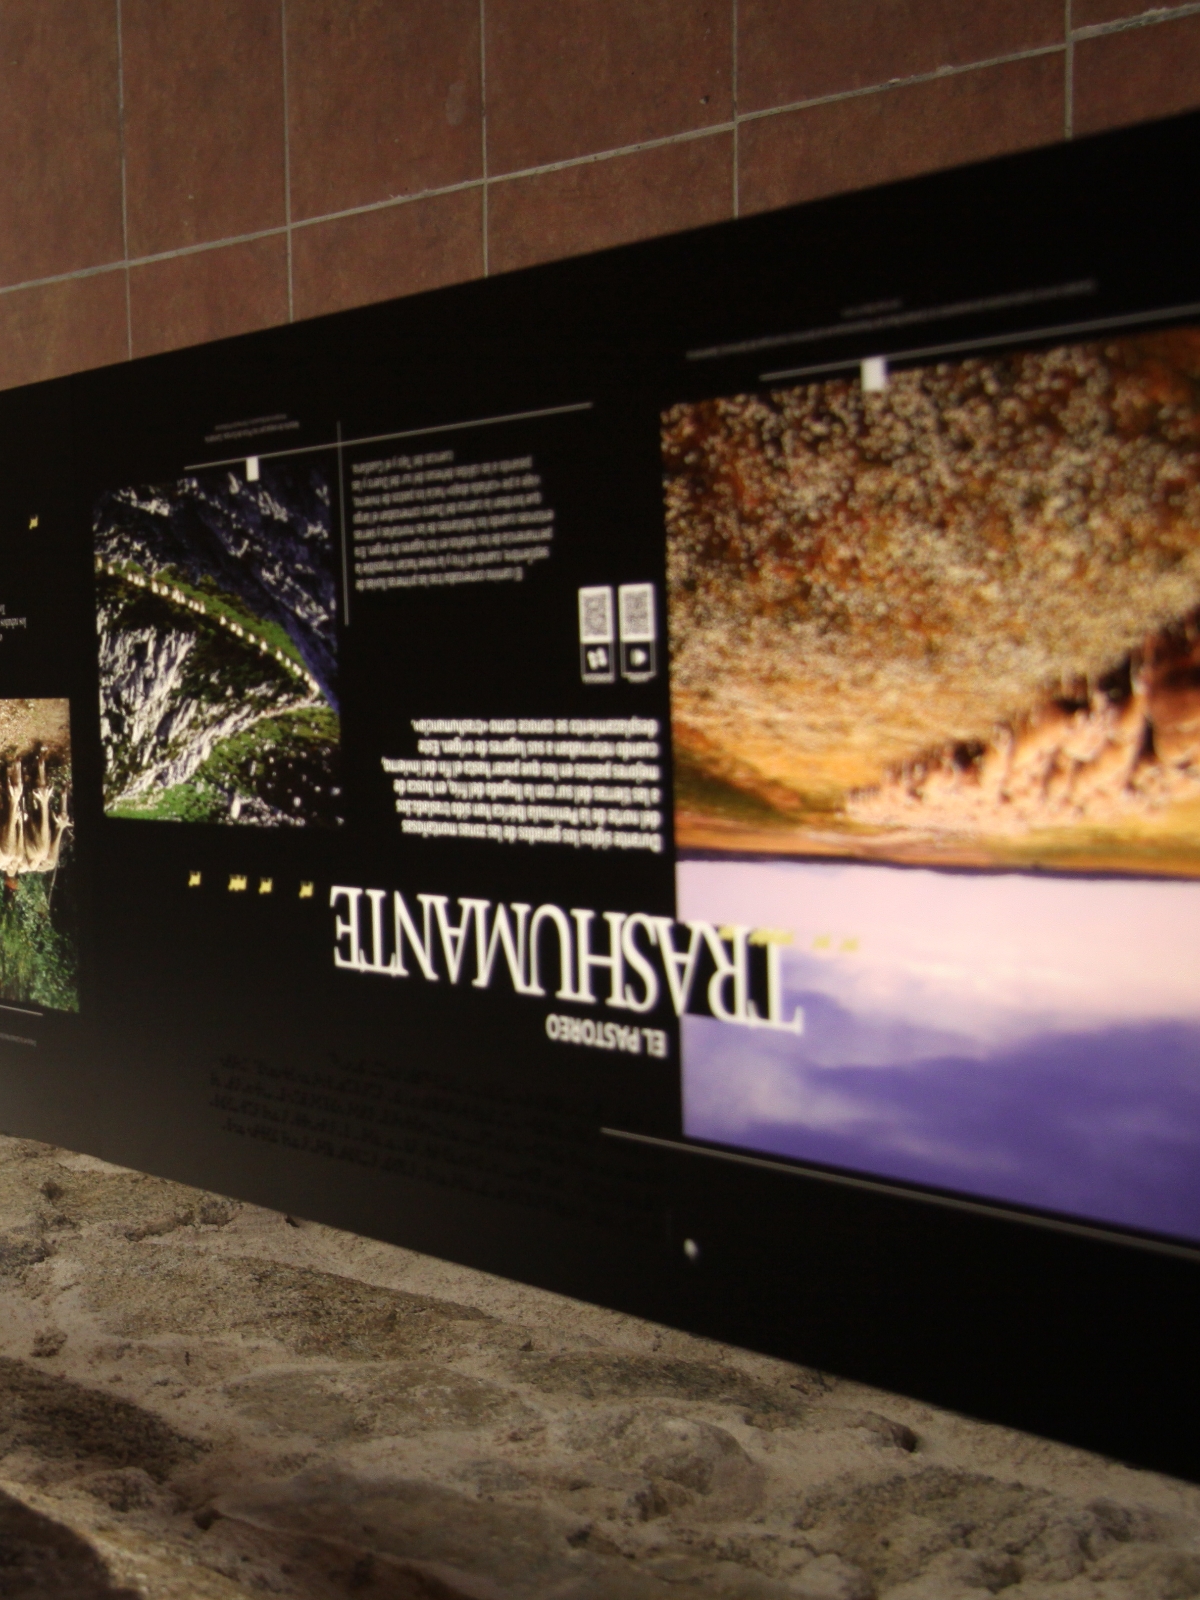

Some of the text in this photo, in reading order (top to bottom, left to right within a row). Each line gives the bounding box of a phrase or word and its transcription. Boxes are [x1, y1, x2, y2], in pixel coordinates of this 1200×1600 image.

[330, 885, 804, 1035] TRASHUMANTE
[545, 1013, 667, 1059] EL PASTOREO
